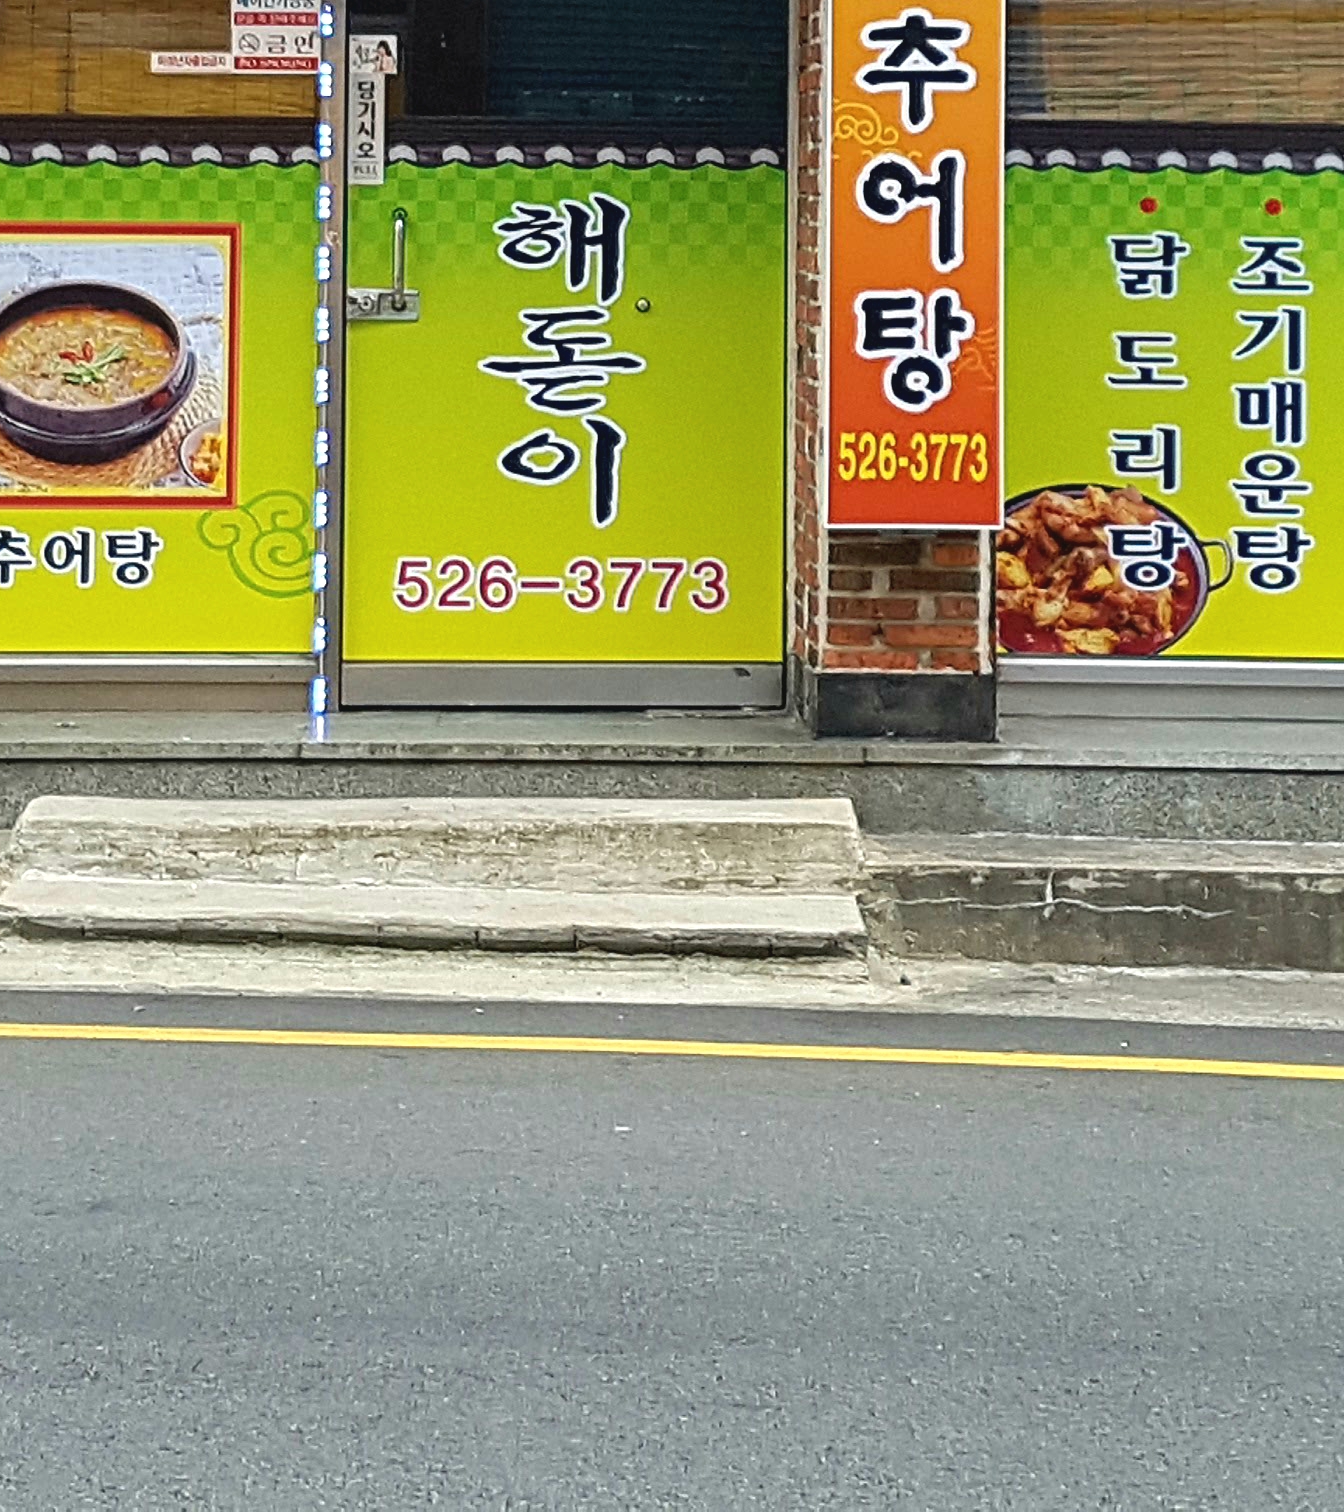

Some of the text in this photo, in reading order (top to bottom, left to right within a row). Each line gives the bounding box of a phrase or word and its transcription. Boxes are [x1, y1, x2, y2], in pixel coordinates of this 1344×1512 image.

[357, 81, 376, 158] 당기시오
[477, 192, 647, 528] 해돋이
[837, 431, 990, 484] 526-3773
[1106, 233, 1190, 593] 닭도리탕
[1230, 234, 1313, 594] 조기매운탕
[392, 555, 730, 613] 526-3773
